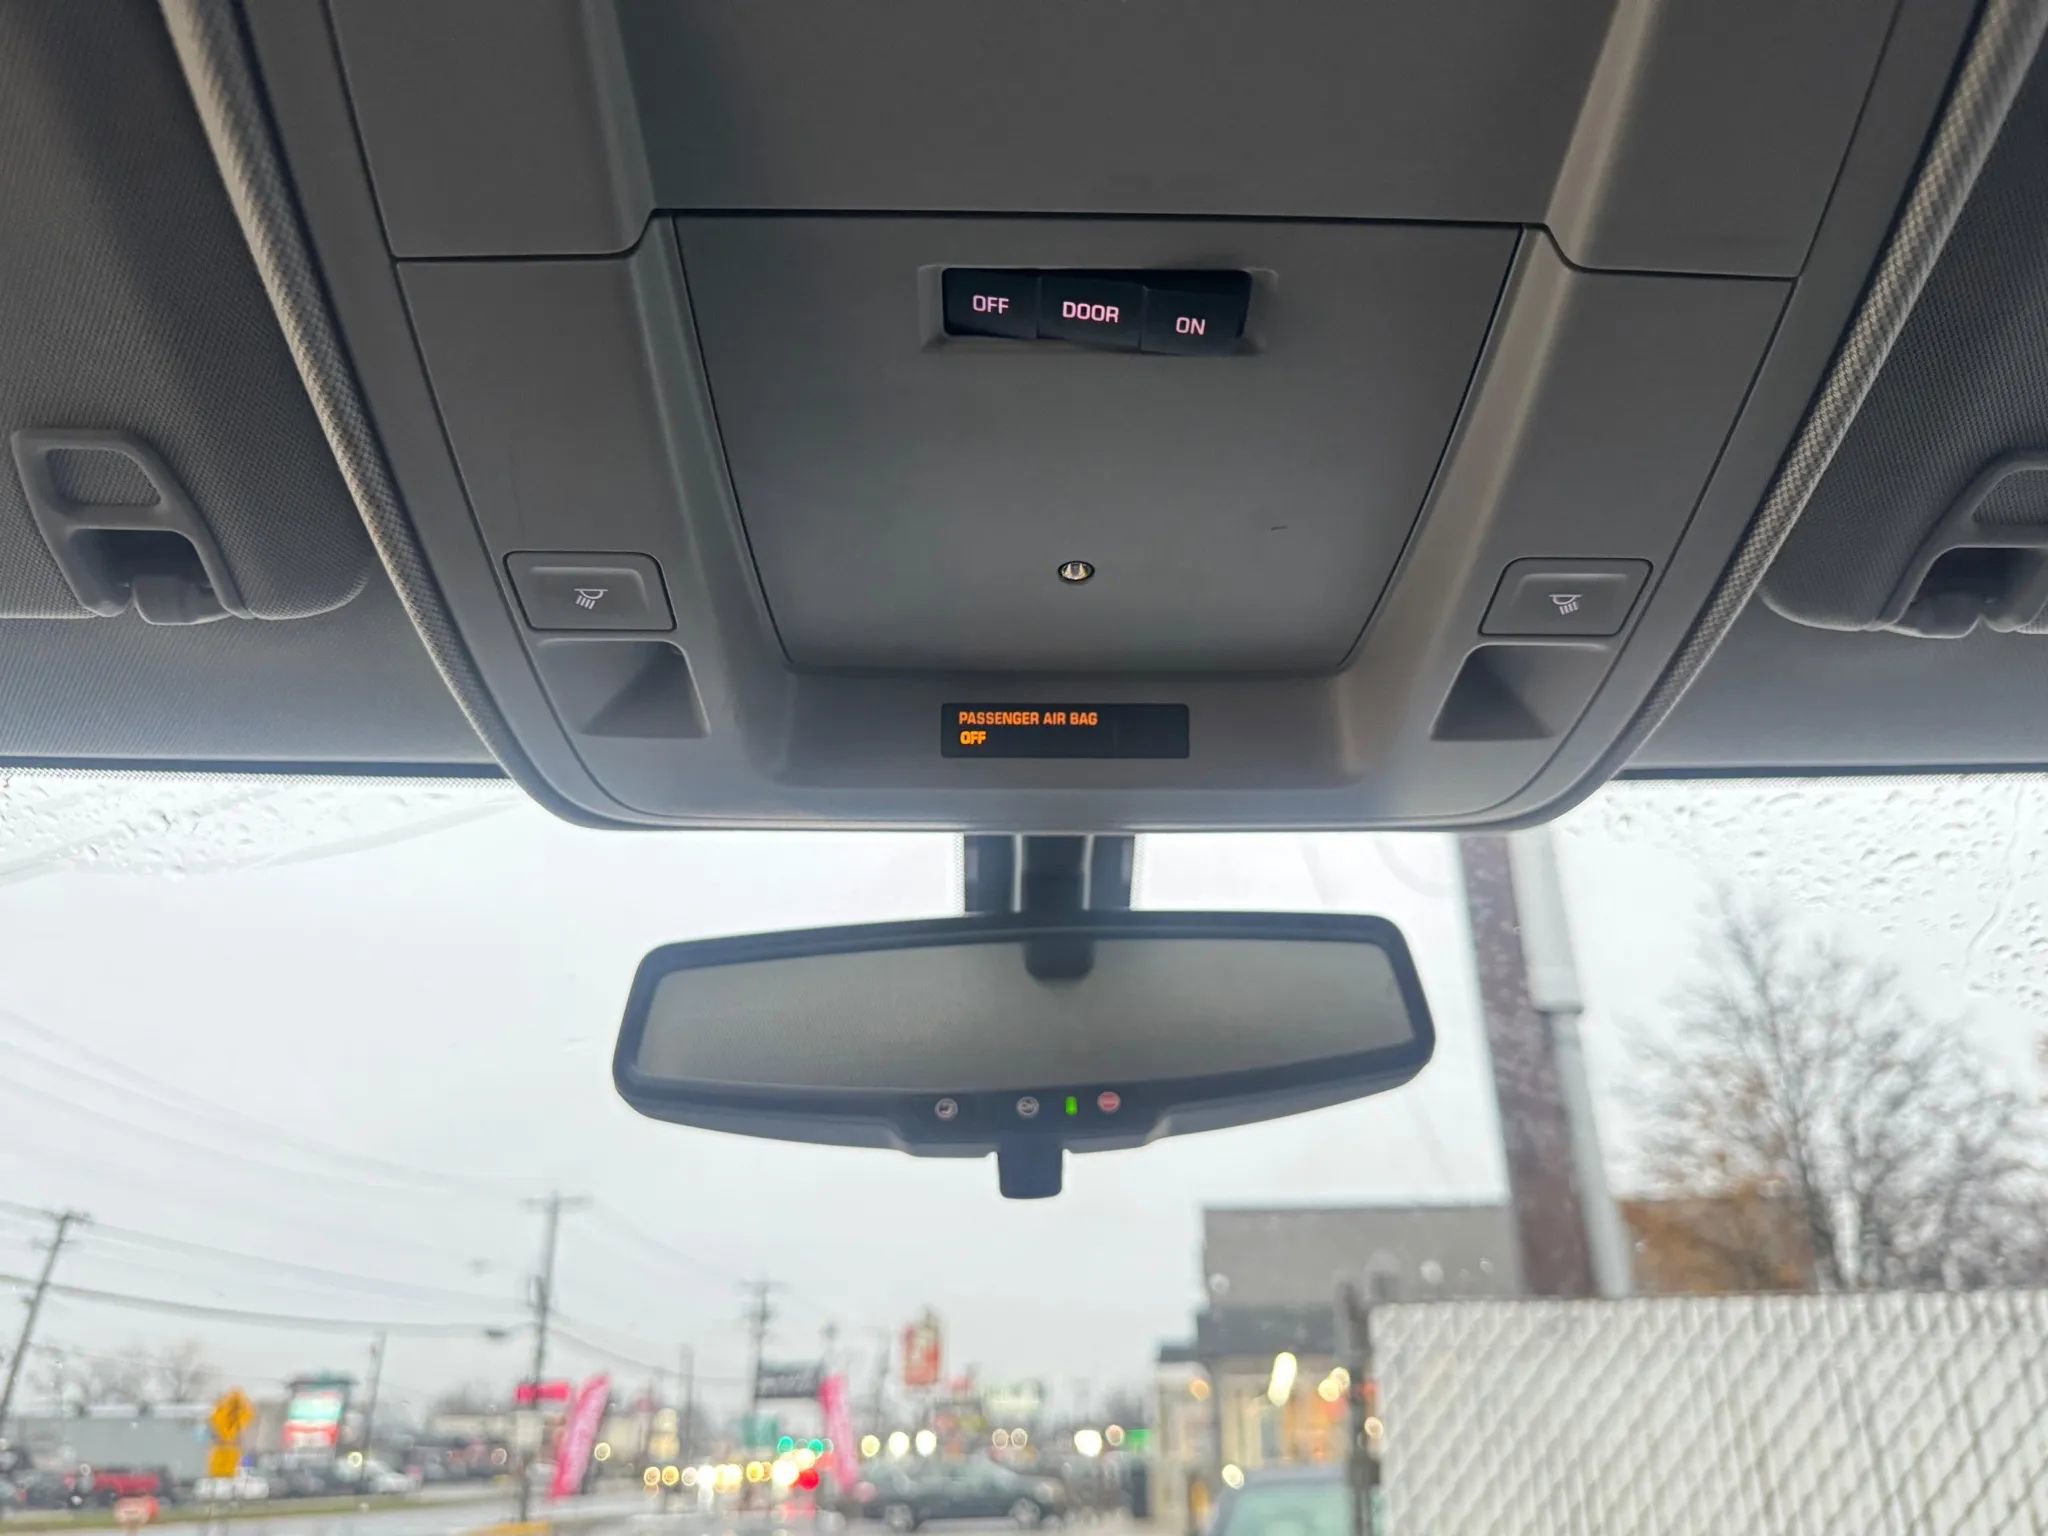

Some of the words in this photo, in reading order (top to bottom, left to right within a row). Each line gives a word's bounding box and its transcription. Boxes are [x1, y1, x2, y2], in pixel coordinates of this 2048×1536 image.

[972, 295, 1009, 314] OFF
[1062, 301, 1119, 323] DOOR
[1175, 317, 1205, 335] ON
[959, 711, 1039, 725] PASSENGER
[1043, 712, 1066, 725] AIR
[1070, 712, 1098, 725] BAG
[960, 731, 987, 745] OFF
